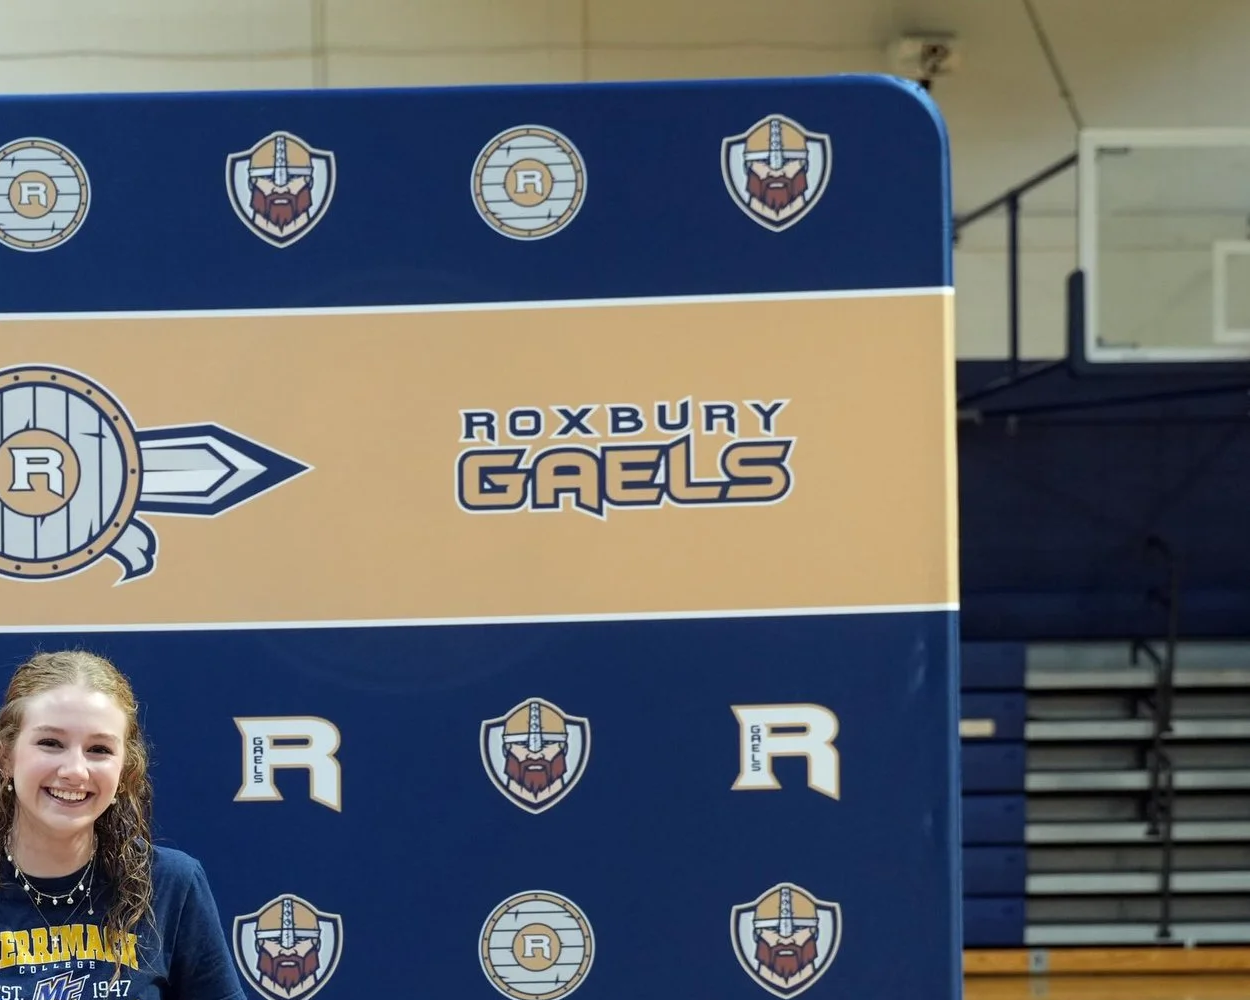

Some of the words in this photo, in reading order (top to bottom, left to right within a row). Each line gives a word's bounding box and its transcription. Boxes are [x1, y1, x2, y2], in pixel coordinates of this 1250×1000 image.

[459, 396, 791, 446] ROXBURY
[7, 447, 66, 499] R
[454, 430, 797, 521] GAELS
[233, 716, 342, 812] R
[253, 736, 264, 784] GAELS
[730, 703, 841, 800] R
[750, 724, 762, 773] GAELS
[19, 960, 96, 975] COLLEGE
[92, 980, 131, 999] 1947
